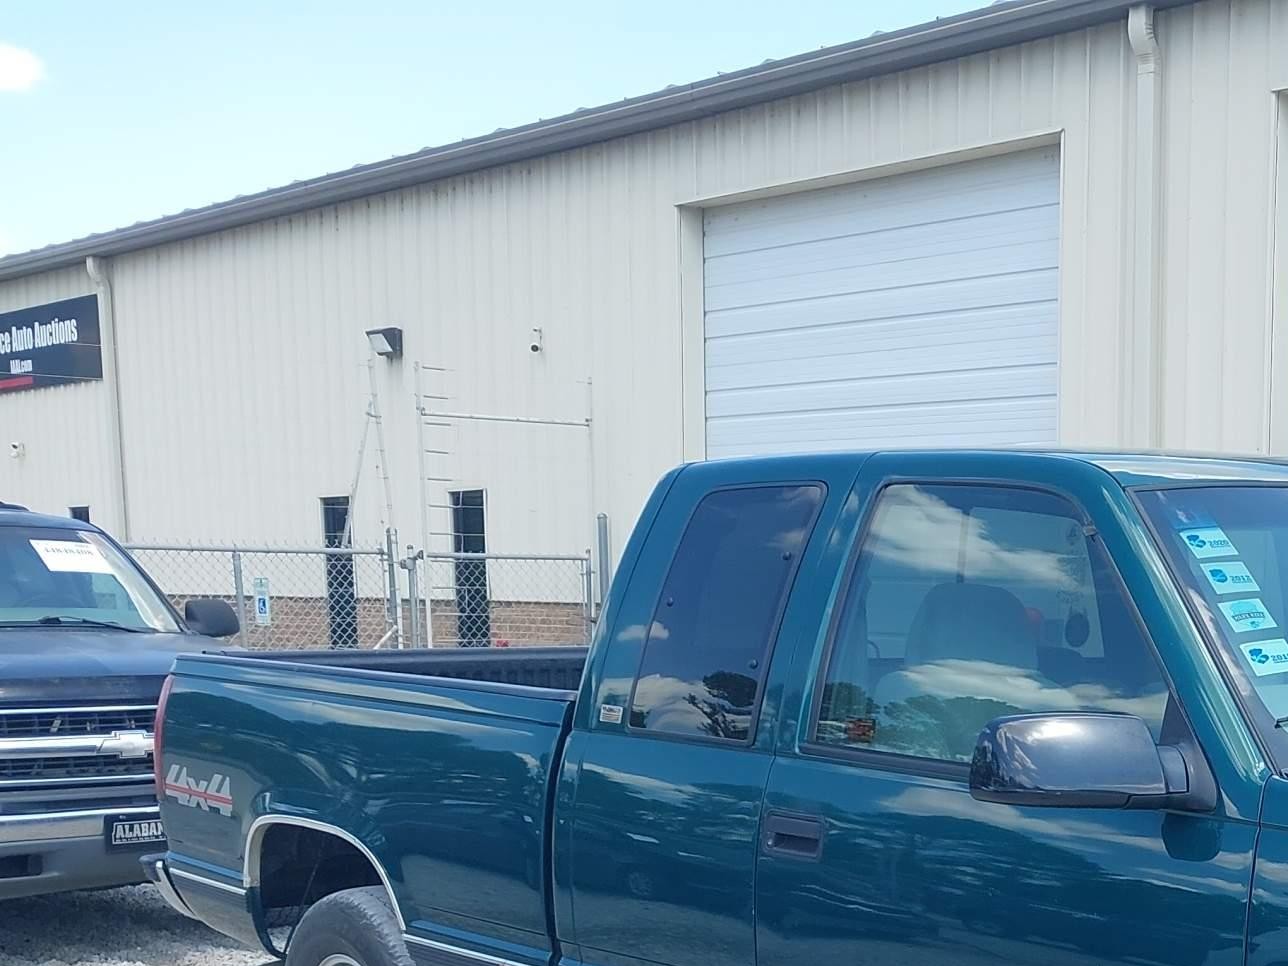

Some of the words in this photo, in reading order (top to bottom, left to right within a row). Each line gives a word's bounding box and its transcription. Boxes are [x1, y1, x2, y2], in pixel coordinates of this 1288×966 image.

[12, 326, 33, 352] Auto
[34, 318, 78, 347] Auctions
[165, 764, 233, 816] 4x4
